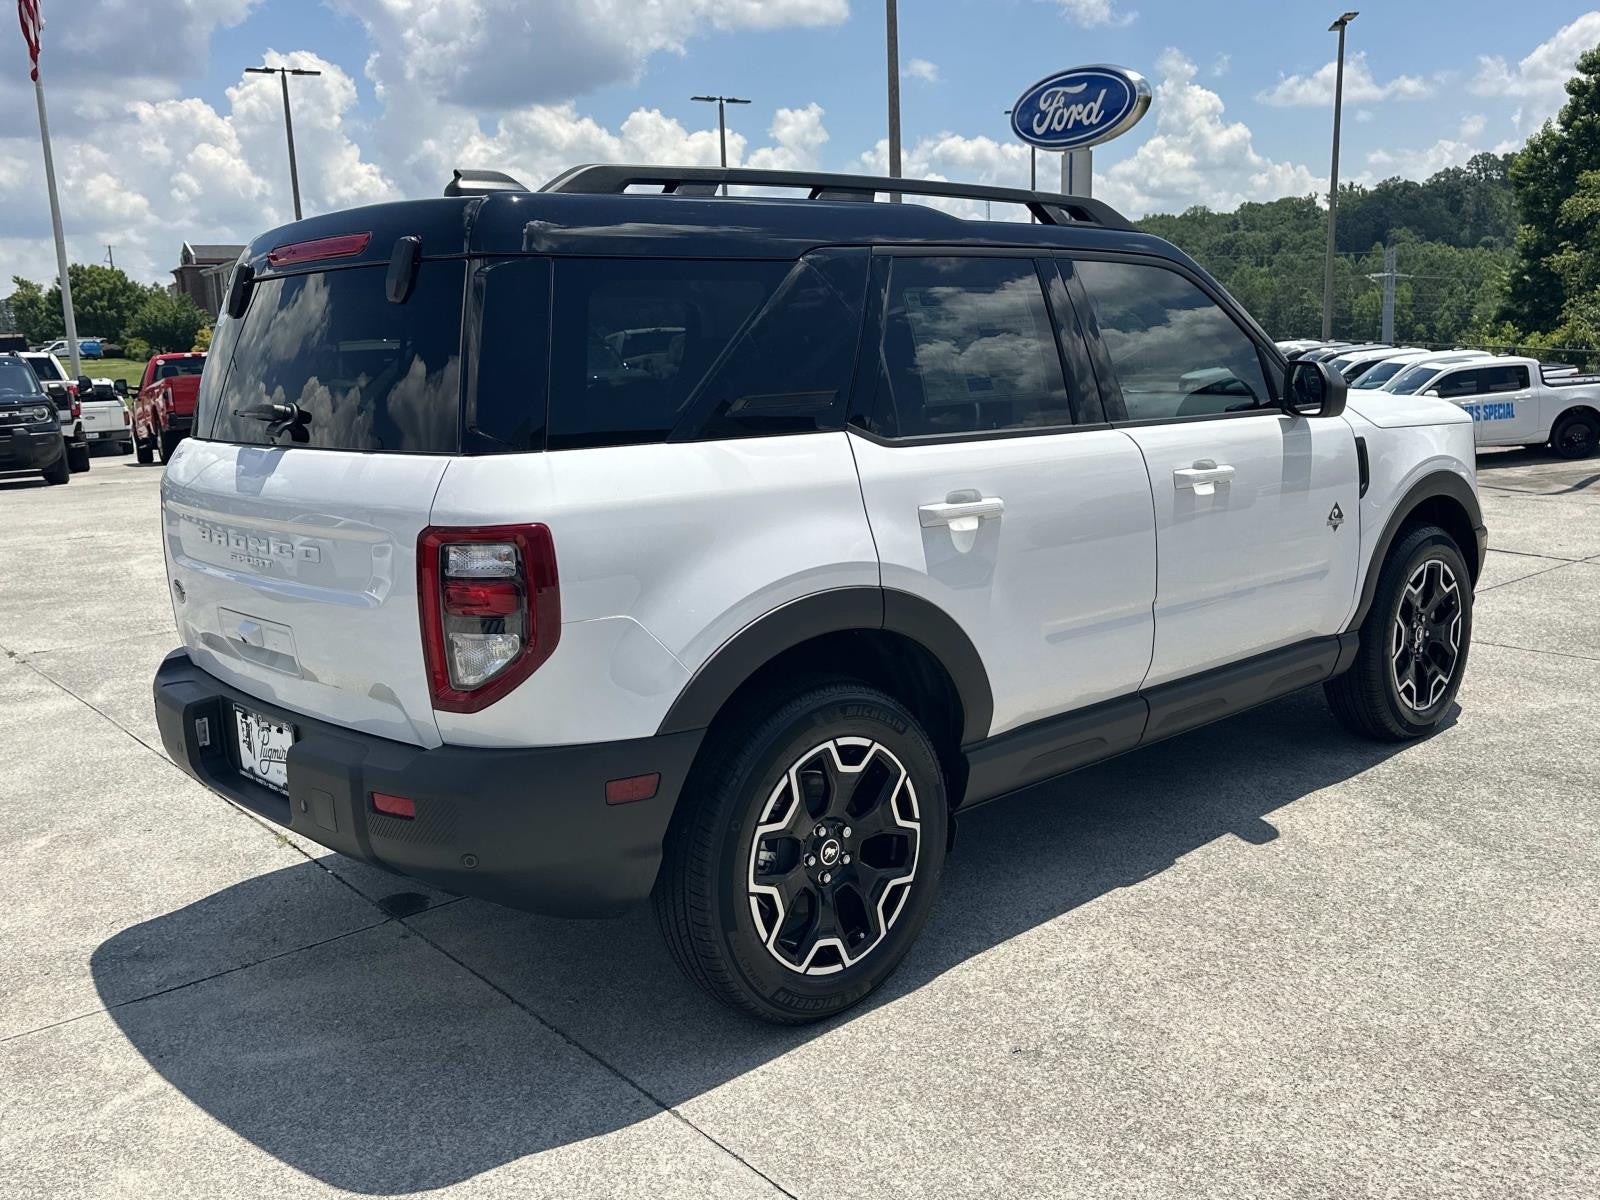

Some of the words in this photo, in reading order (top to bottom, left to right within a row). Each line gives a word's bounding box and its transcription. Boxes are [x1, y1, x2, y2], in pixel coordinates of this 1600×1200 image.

[1032, 82, 1108, 135] Ford
[1483, 402, 1515, 420] SPECIAL
[199, 526, 321, 564] BRONCO
[230, 552, 273, 569] SPORT
[258, 727, 288, 775] Pugmir
